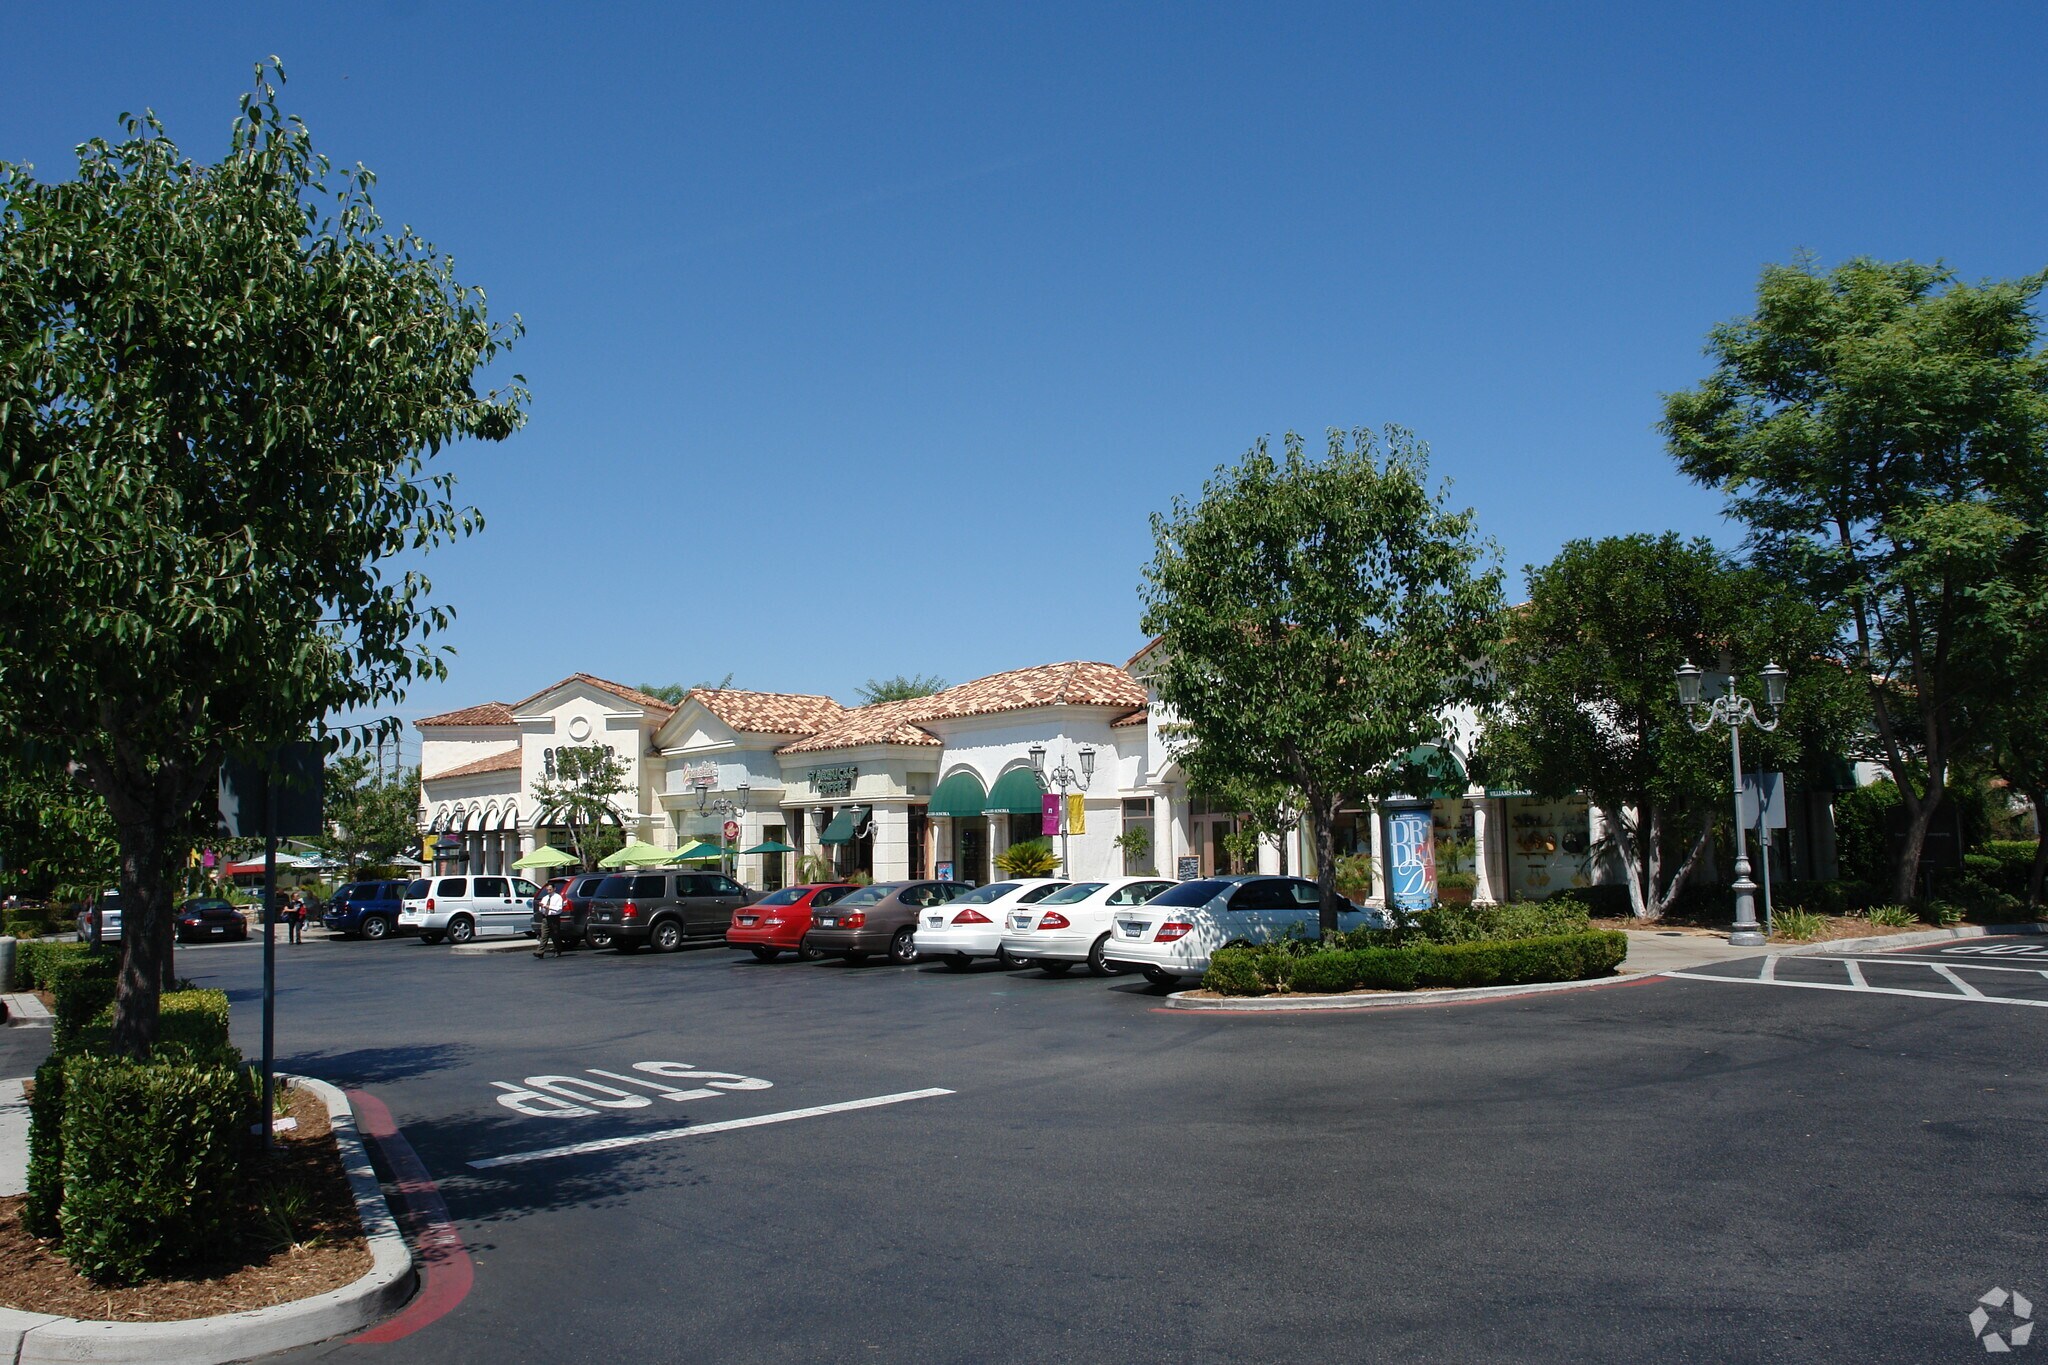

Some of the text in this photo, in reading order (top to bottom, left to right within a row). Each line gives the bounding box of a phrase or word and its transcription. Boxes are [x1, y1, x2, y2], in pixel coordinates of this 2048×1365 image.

[807, 767, 856, 781] STARBUCKS
[818, 780, 849, 793] COFFEE
[1489, 788, 1538, 797] WILLIAMS-SO
[489, 1061, 774, 1118] STOP
